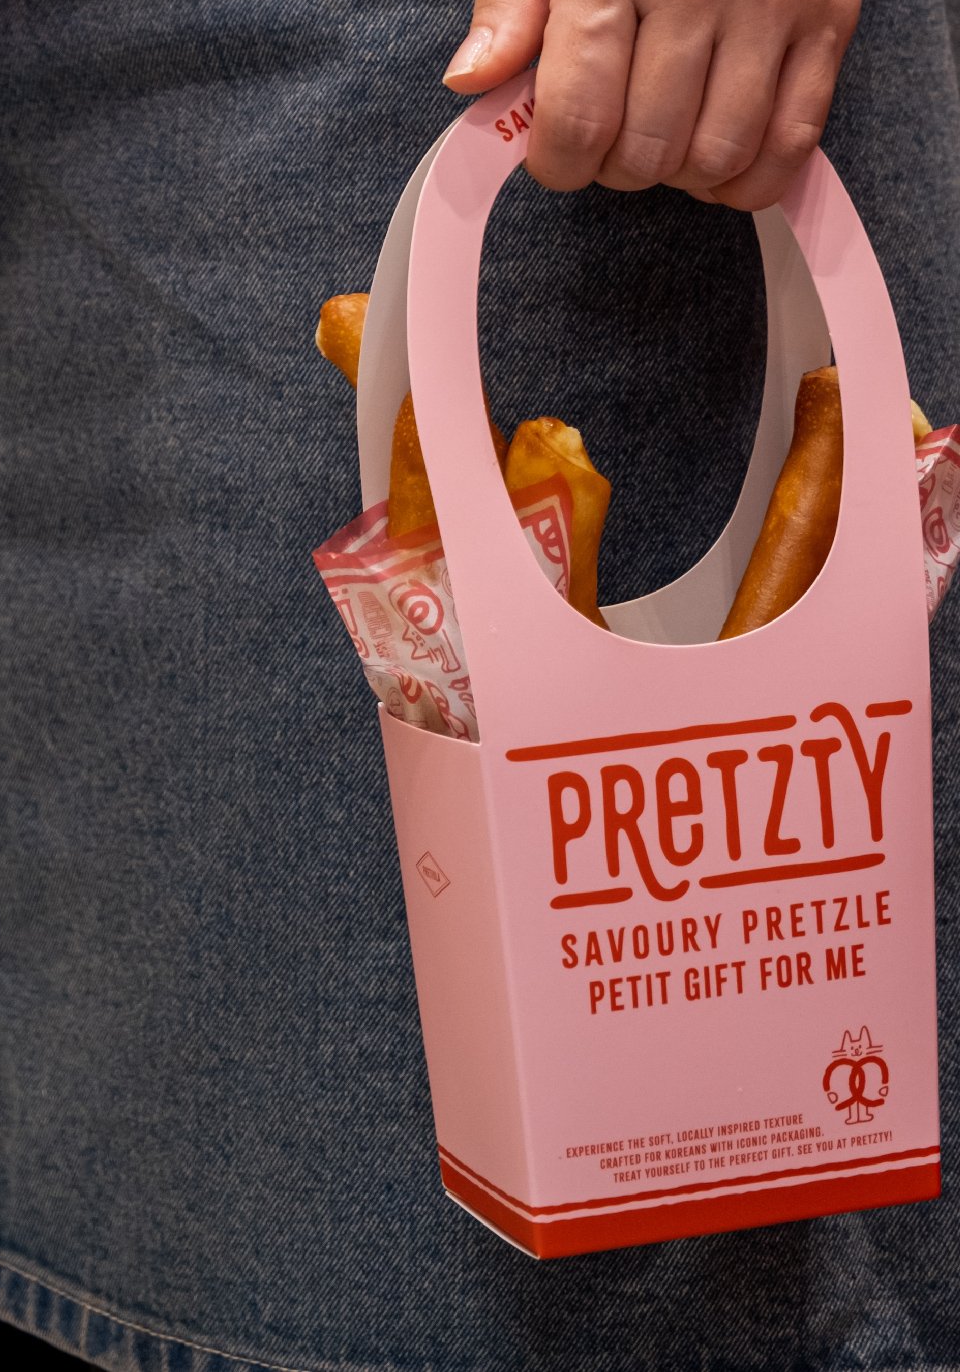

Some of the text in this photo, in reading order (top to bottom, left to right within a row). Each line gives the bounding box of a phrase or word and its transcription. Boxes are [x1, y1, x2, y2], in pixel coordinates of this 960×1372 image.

[561, 890, 892, 969] SAVOURY PRETZLE
[588, 943, 867, 1015] PETIT GIFT FOR ME
[566, 1113, 803, 1158] EXPERIENCE THE SOFT, LOCALLY INSPIRED TEXTURE
[600, 1126, 824, 1170] CRAFTED FOR KOREANS WITH ICONIC PACKAGING.
[613, 1130, 893, 1183] TREAT YOURSELF TO THE PERFECT GIFT. SEE YOU AT PRETZTY!
